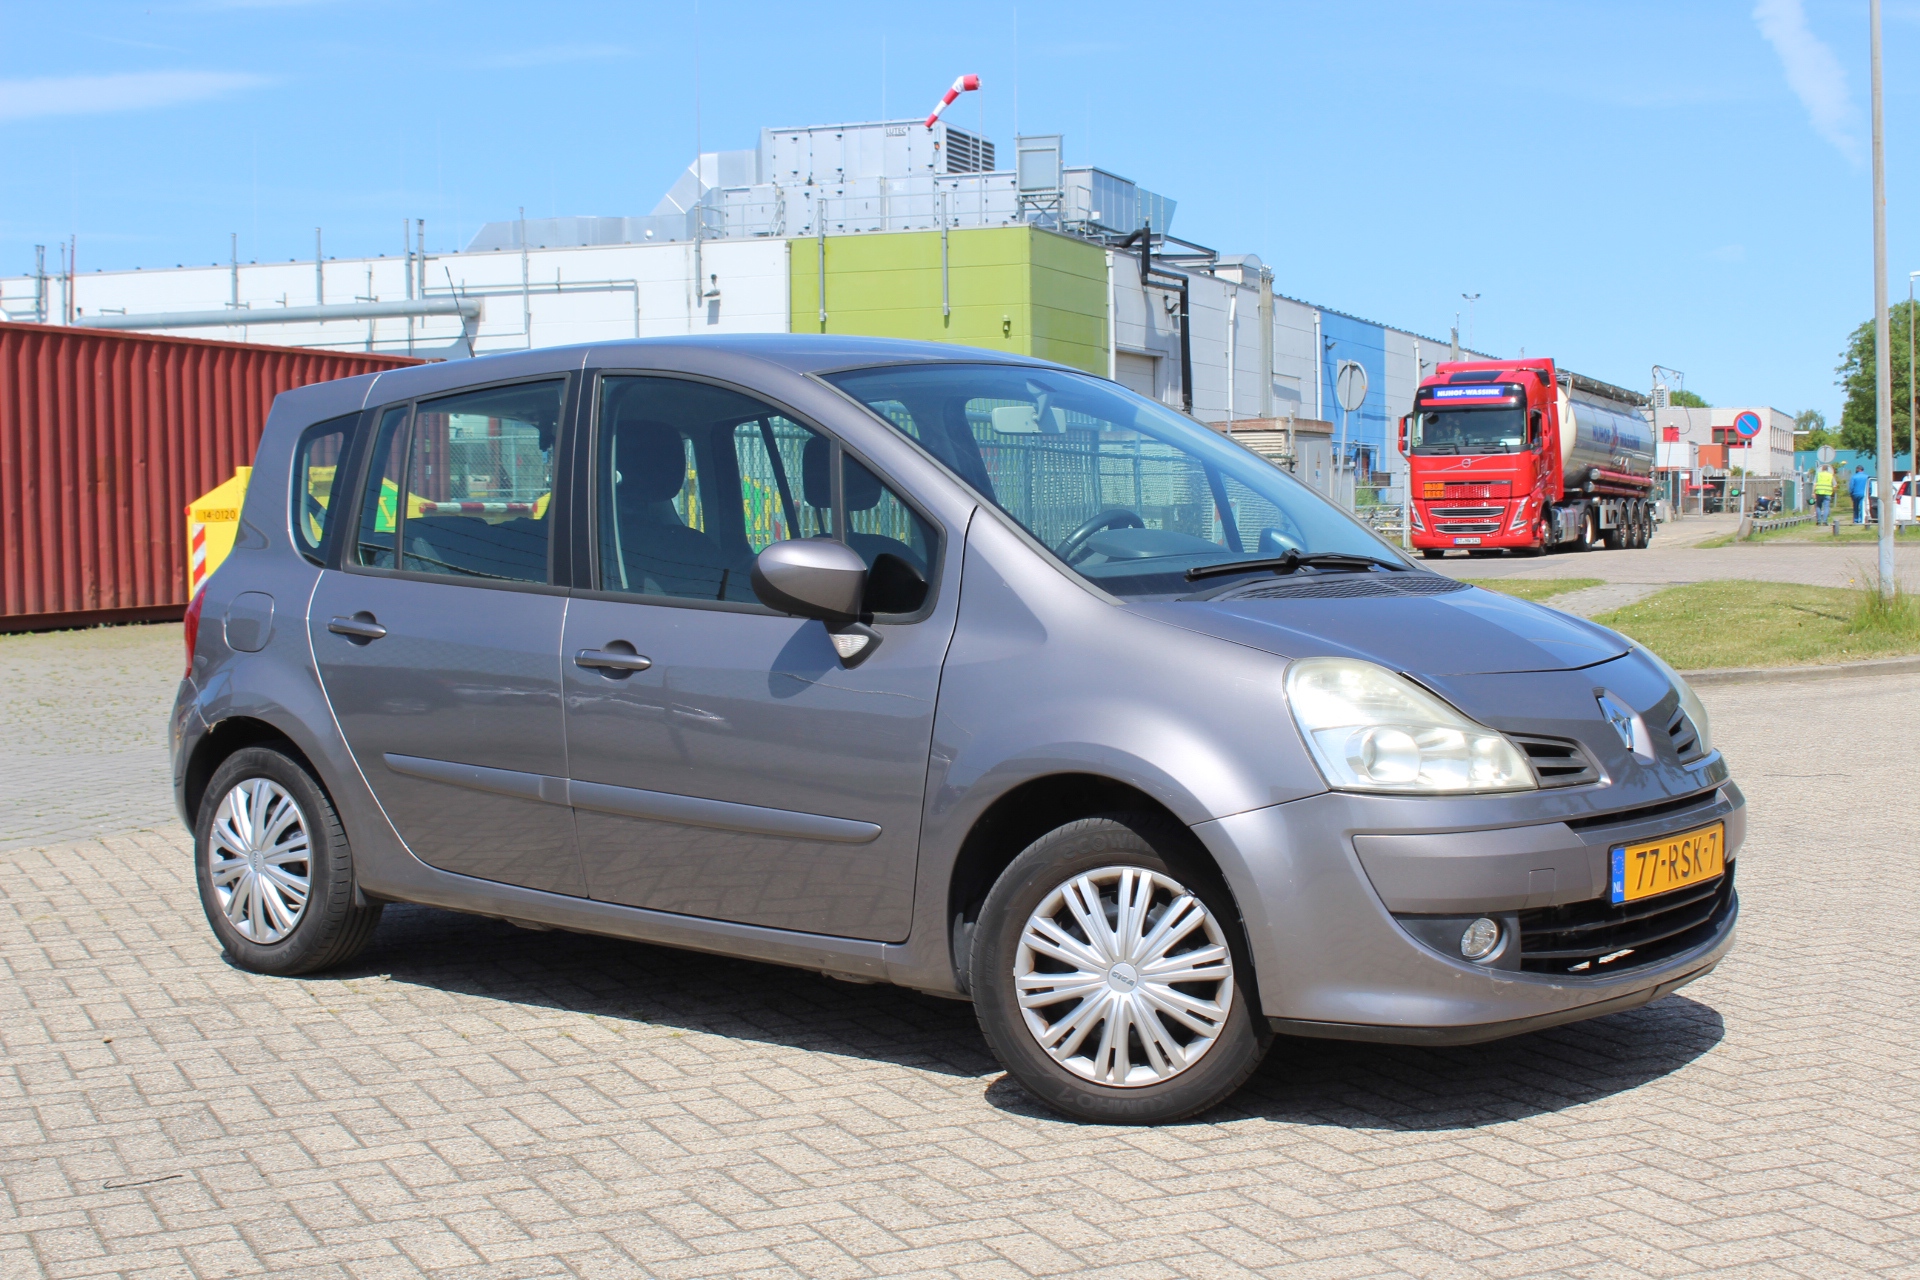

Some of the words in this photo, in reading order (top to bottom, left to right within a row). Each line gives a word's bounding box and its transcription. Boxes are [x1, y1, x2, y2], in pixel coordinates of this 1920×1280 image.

[886, 126, 906, 134] LUTEC
[202, 509, 236, 520] 14-0120
[1635, 832, 1717, 890] 77-RSK-7
[1613, 881, 1623, 893] NL
[1111, 970, 1135, 987] GIGA
[1076, 1093, 1177, 1115] KUMHO
